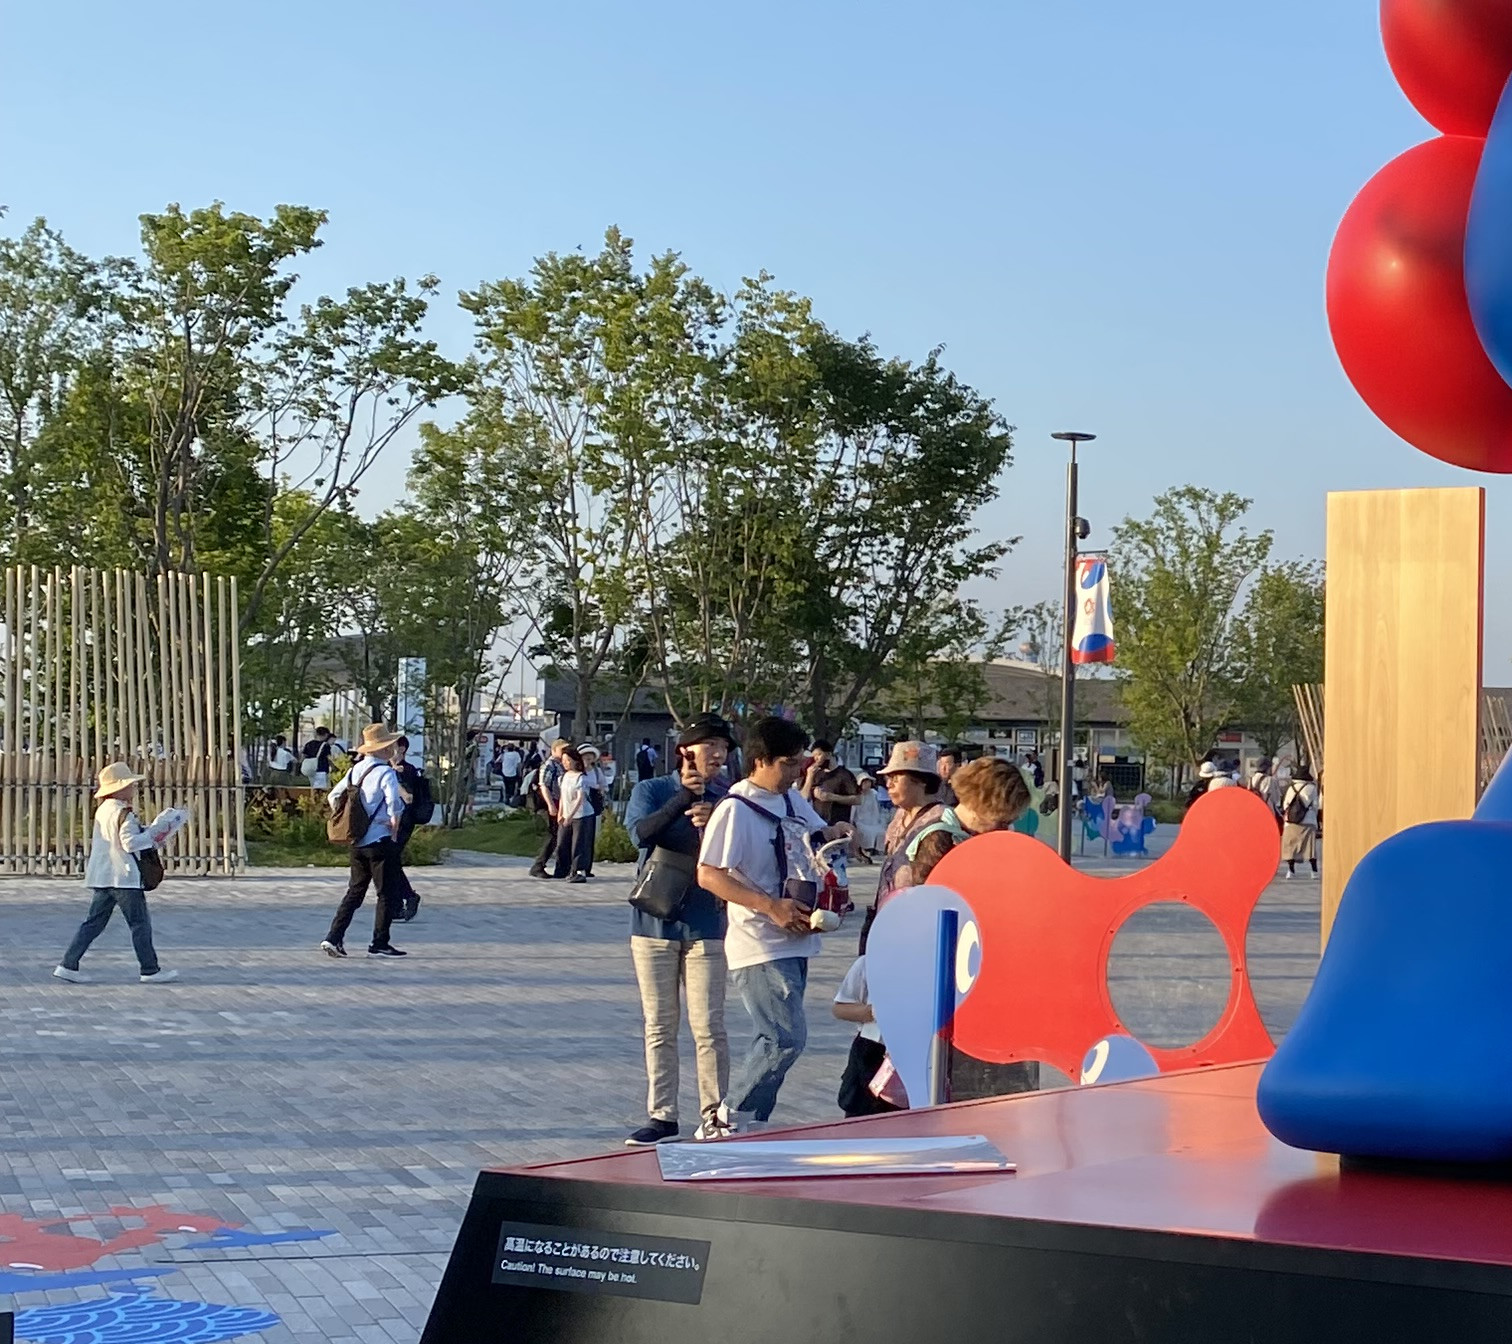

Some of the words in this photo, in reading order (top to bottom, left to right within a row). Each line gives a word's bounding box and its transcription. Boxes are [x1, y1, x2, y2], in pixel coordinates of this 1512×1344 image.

[501, 1259, 536, 1273] Caution!
[538, 1263, 553, 1275] The
[554, 1266, 587, 1279] surface
[587, 1270, 607, 1283] may
[607, 1270, 619, 1281] be
